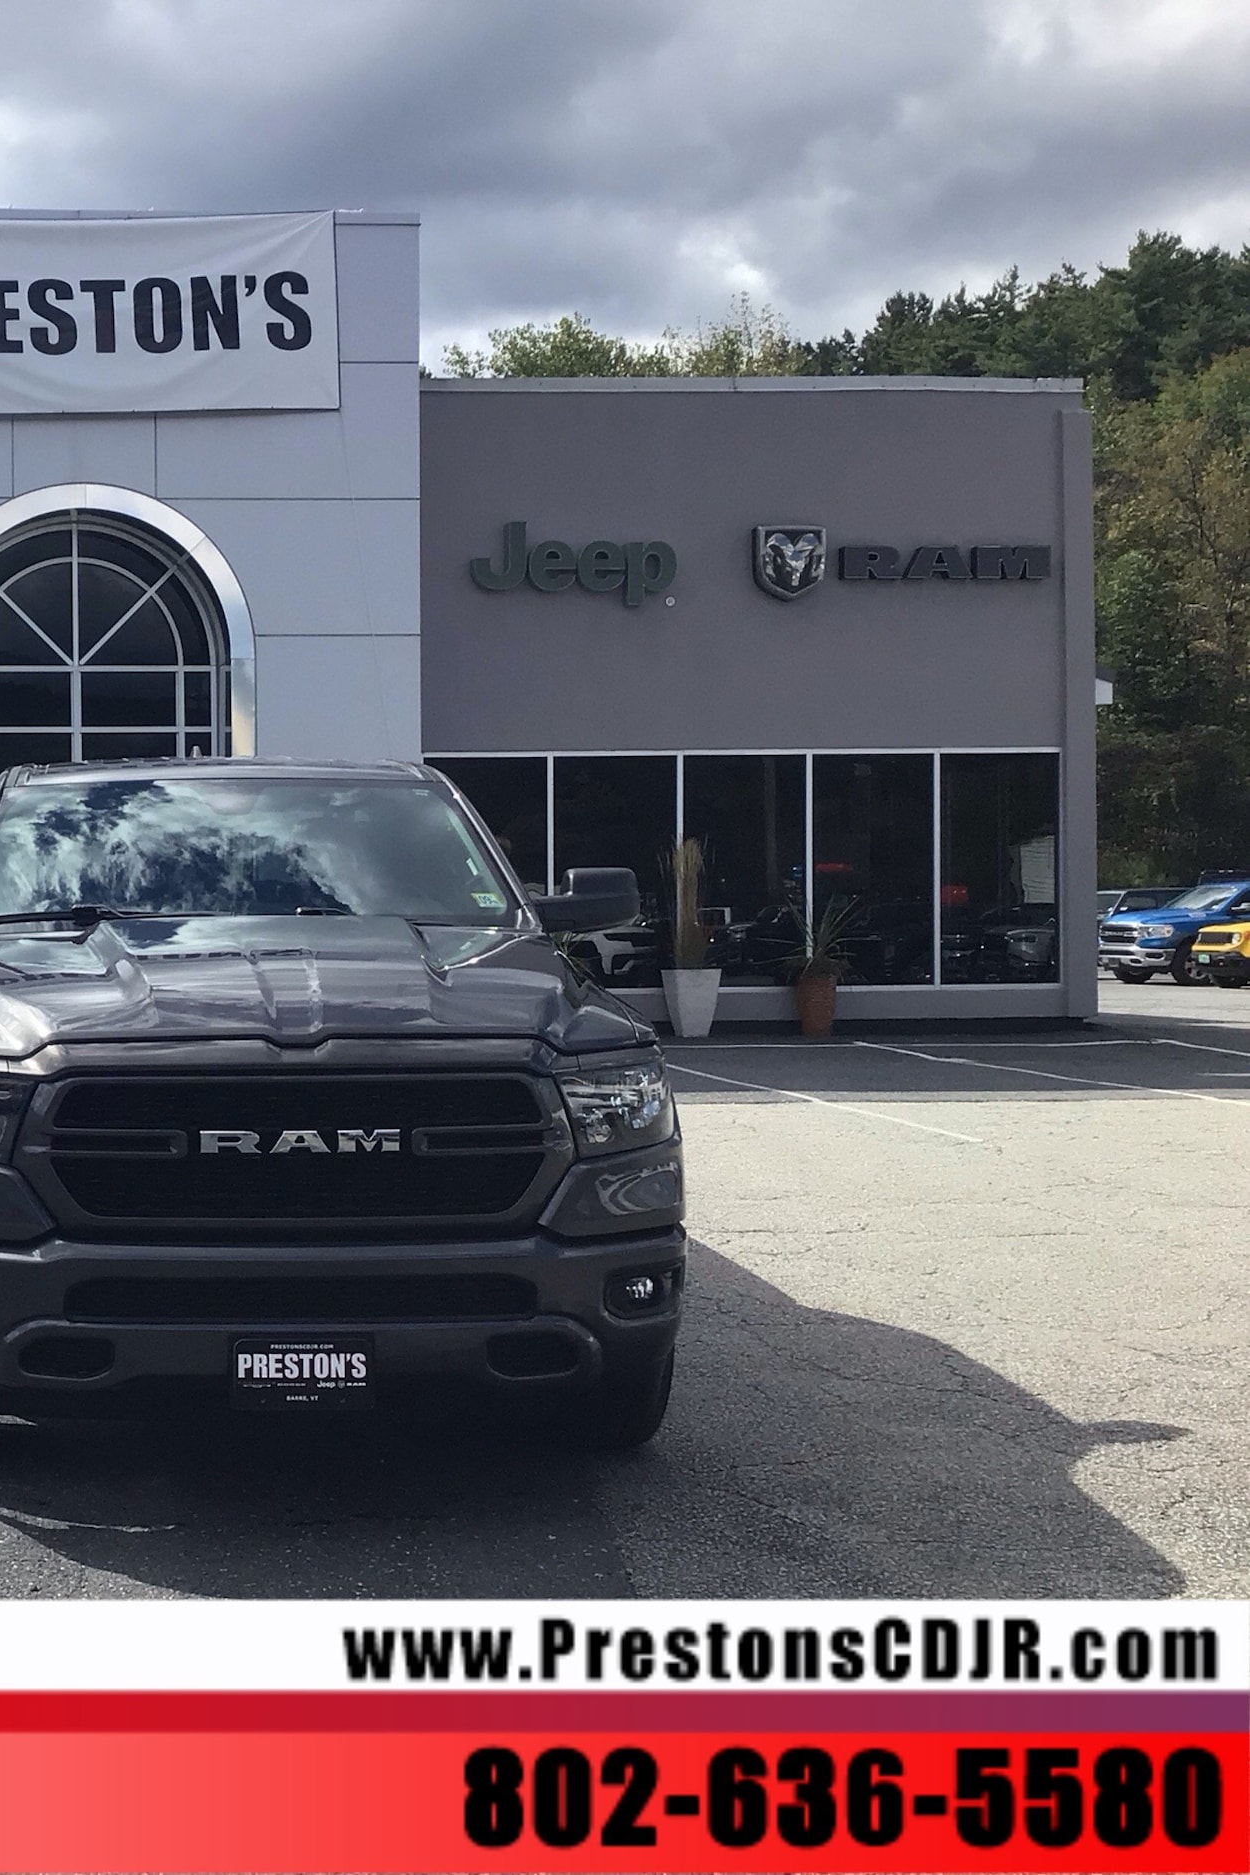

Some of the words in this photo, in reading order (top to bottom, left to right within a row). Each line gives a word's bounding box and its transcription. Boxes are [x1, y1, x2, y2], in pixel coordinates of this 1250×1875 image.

[470, 521, 677, 606] Jeep
[838, 545, 1051, 581] RAM
[198, 1128, 401, 1155] RAM
[237, 1353, 367, 1379] PRESTON'S
